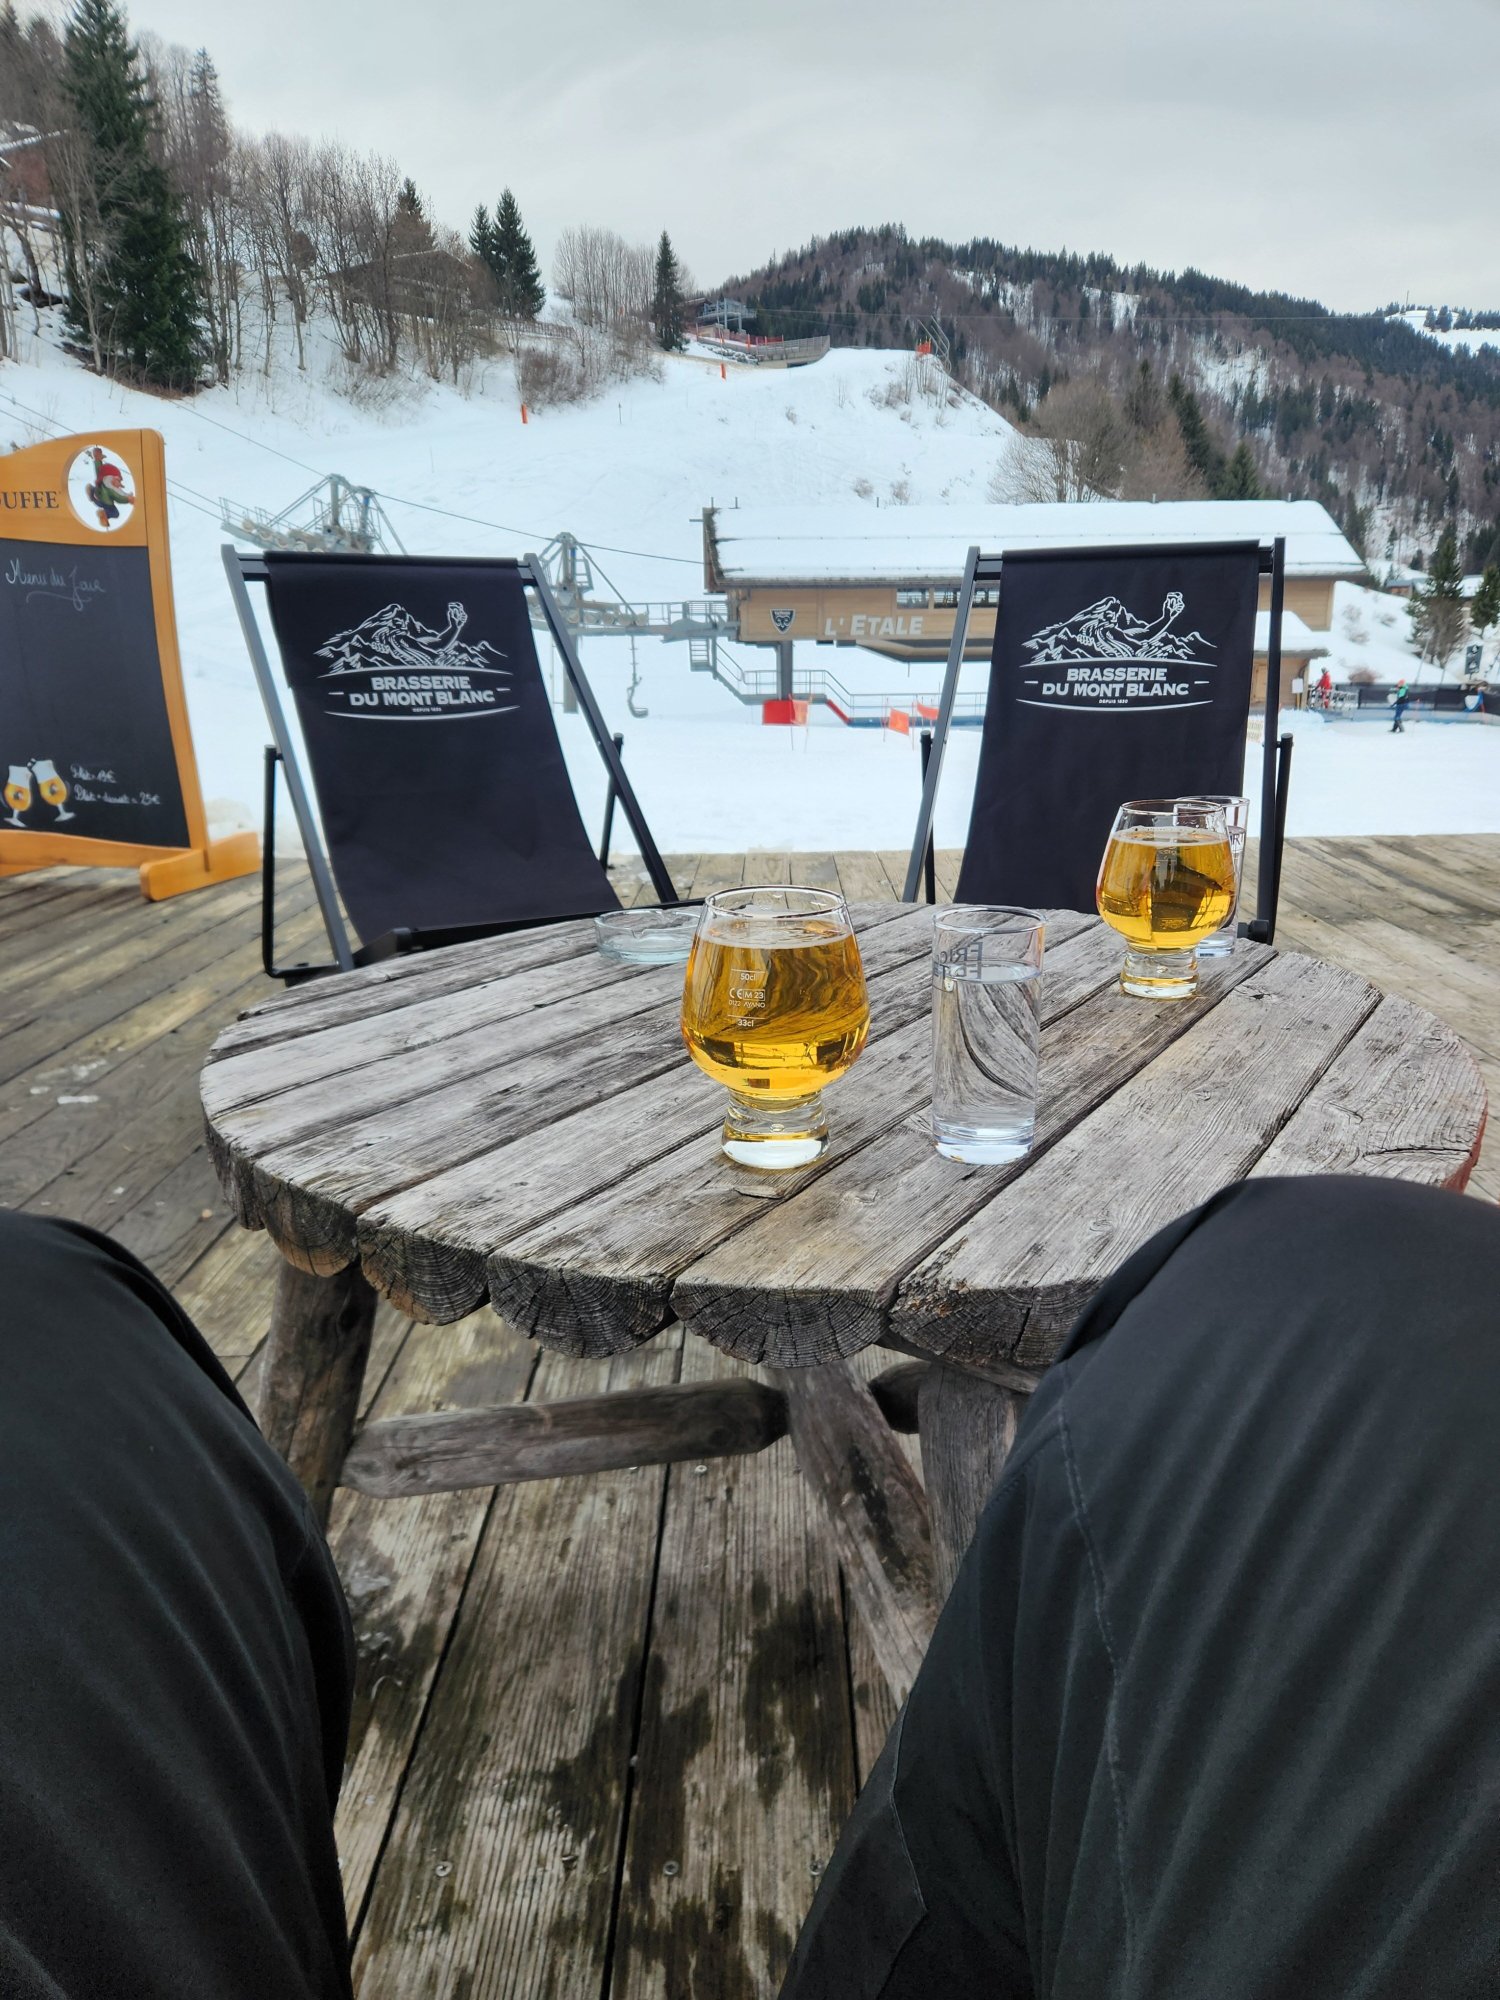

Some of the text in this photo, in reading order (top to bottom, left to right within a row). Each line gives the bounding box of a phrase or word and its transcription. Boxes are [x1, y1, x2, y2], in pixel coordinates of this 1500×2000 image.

[0, 491, 60, 509] UFFE
[1066, 667, 1168, 682] BRASSERIE
[370, 676, 471, 691] BRASSERIE
[1041, 683, 1189, 697] DU MONT BLANC
[348, 690, 496, 707] DU MONT BLANC
[740, 972, 756, 981] 50cl
[754, 991, 764, 999] 23
[737, 1018, 754, 1027] 33cl
